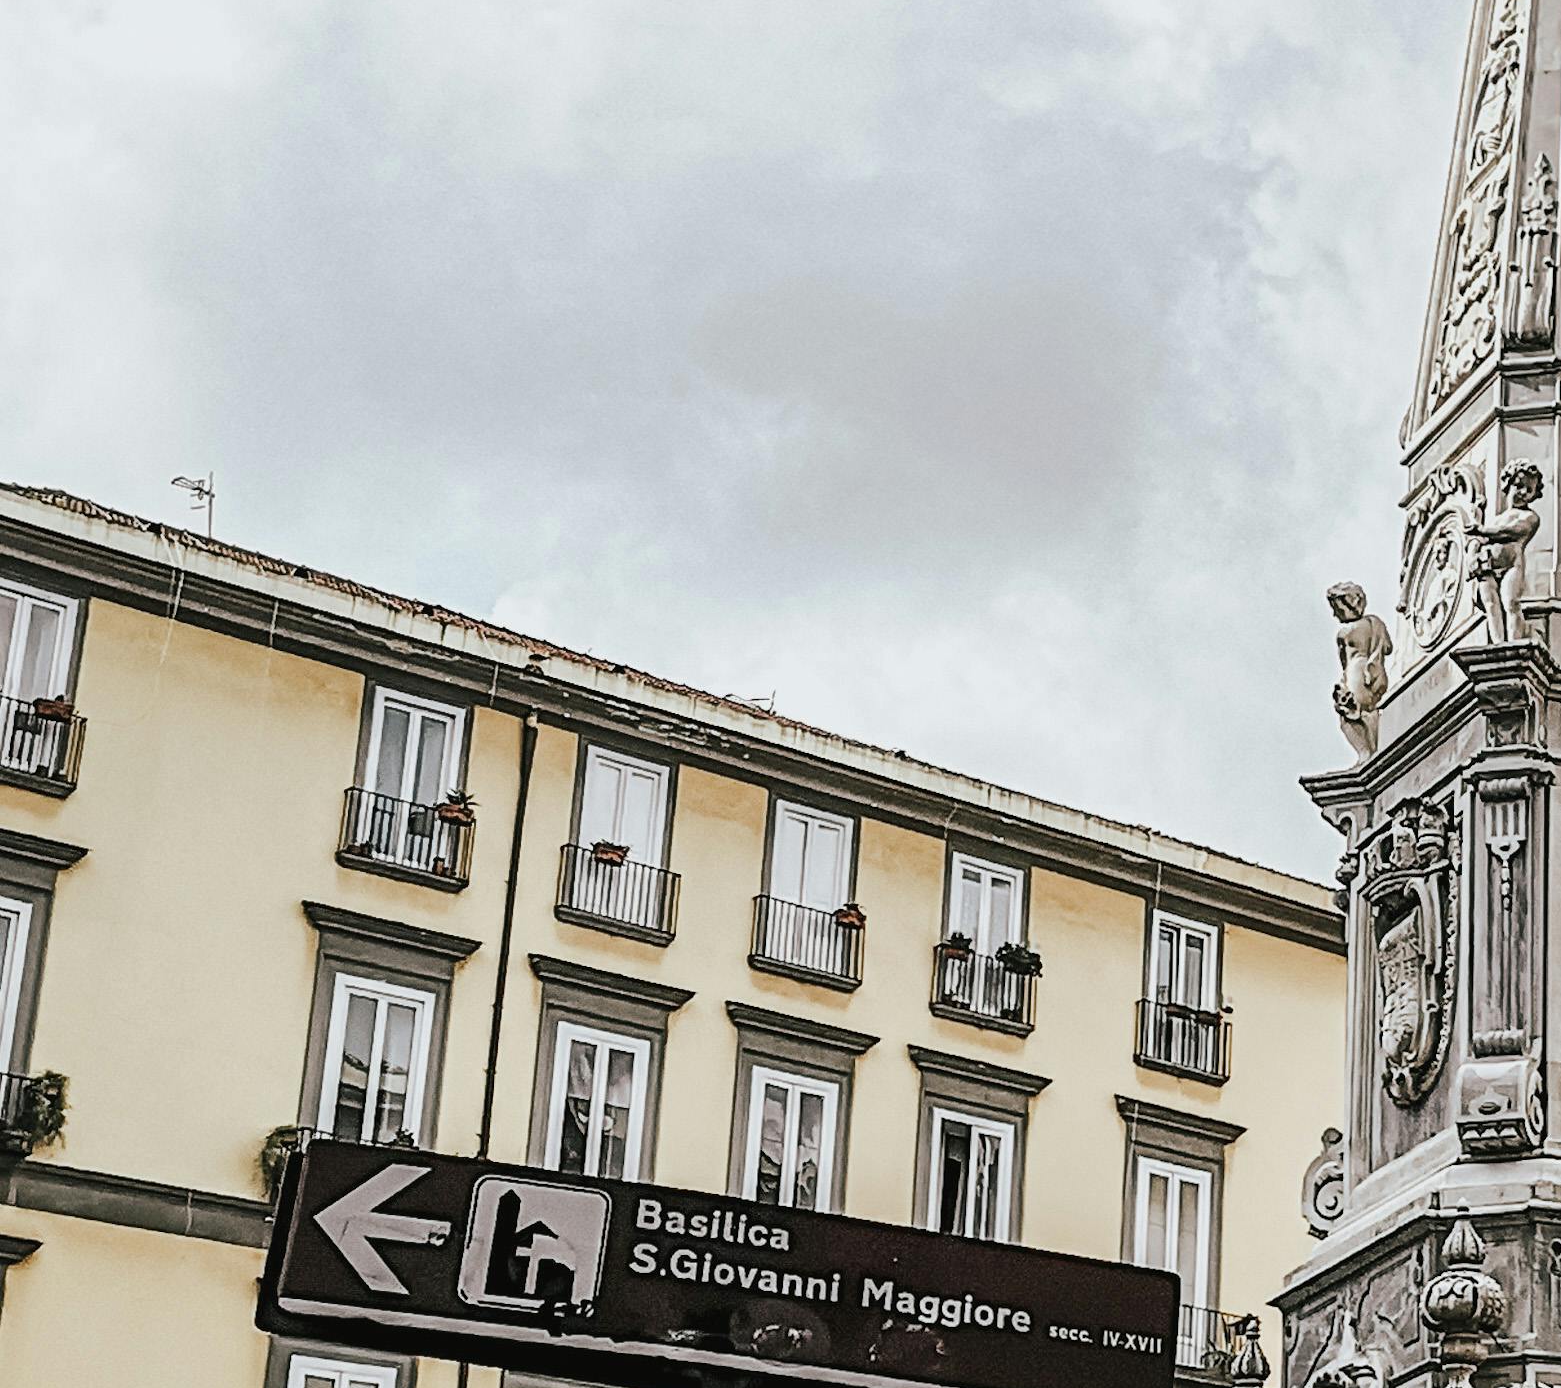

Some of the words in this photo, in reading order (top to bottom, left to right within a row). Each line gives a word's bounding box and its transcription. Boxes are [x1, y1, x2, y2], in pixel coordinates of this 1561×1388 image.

[636, 1199, 790, 1252] Basilica
[629, 1243, 842, 1304] S.Giovanni
[861, 1278, 1032, 1334] Maggiore
[1048, 1324, 1094, 1344] secc.
[1102, 1329, 1163, 1355] IV-XVII
